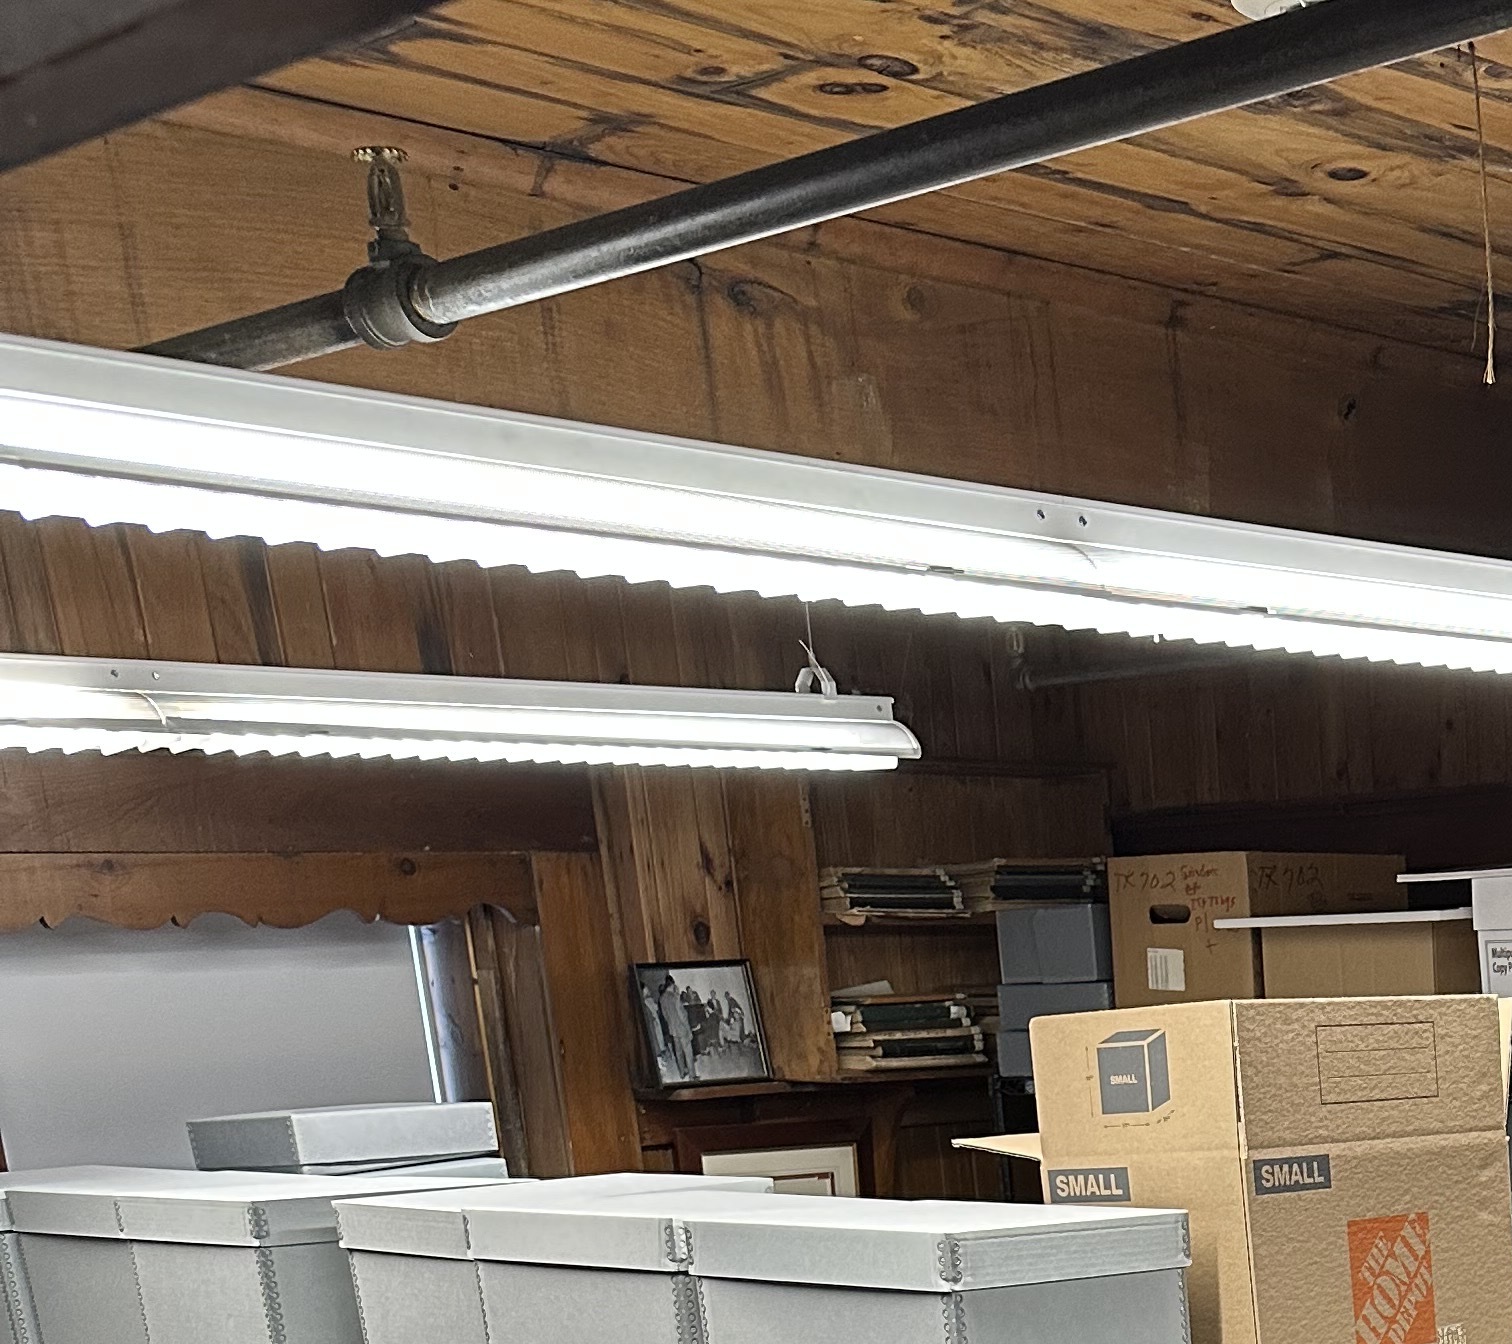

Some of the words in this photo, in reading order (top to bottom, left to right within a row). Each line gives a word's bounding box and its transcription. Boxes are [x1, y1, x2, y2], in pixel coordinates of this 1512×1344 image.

[1492, 962, 1508, 976] Copy
[1109, 1073, 1139, 1085] SMALL
[1055, 1173, 1124, 1198] SMALL
[1261, 1161, 1325, 1188] SMALL
[1358, 1231, 1392, 1287] THE
